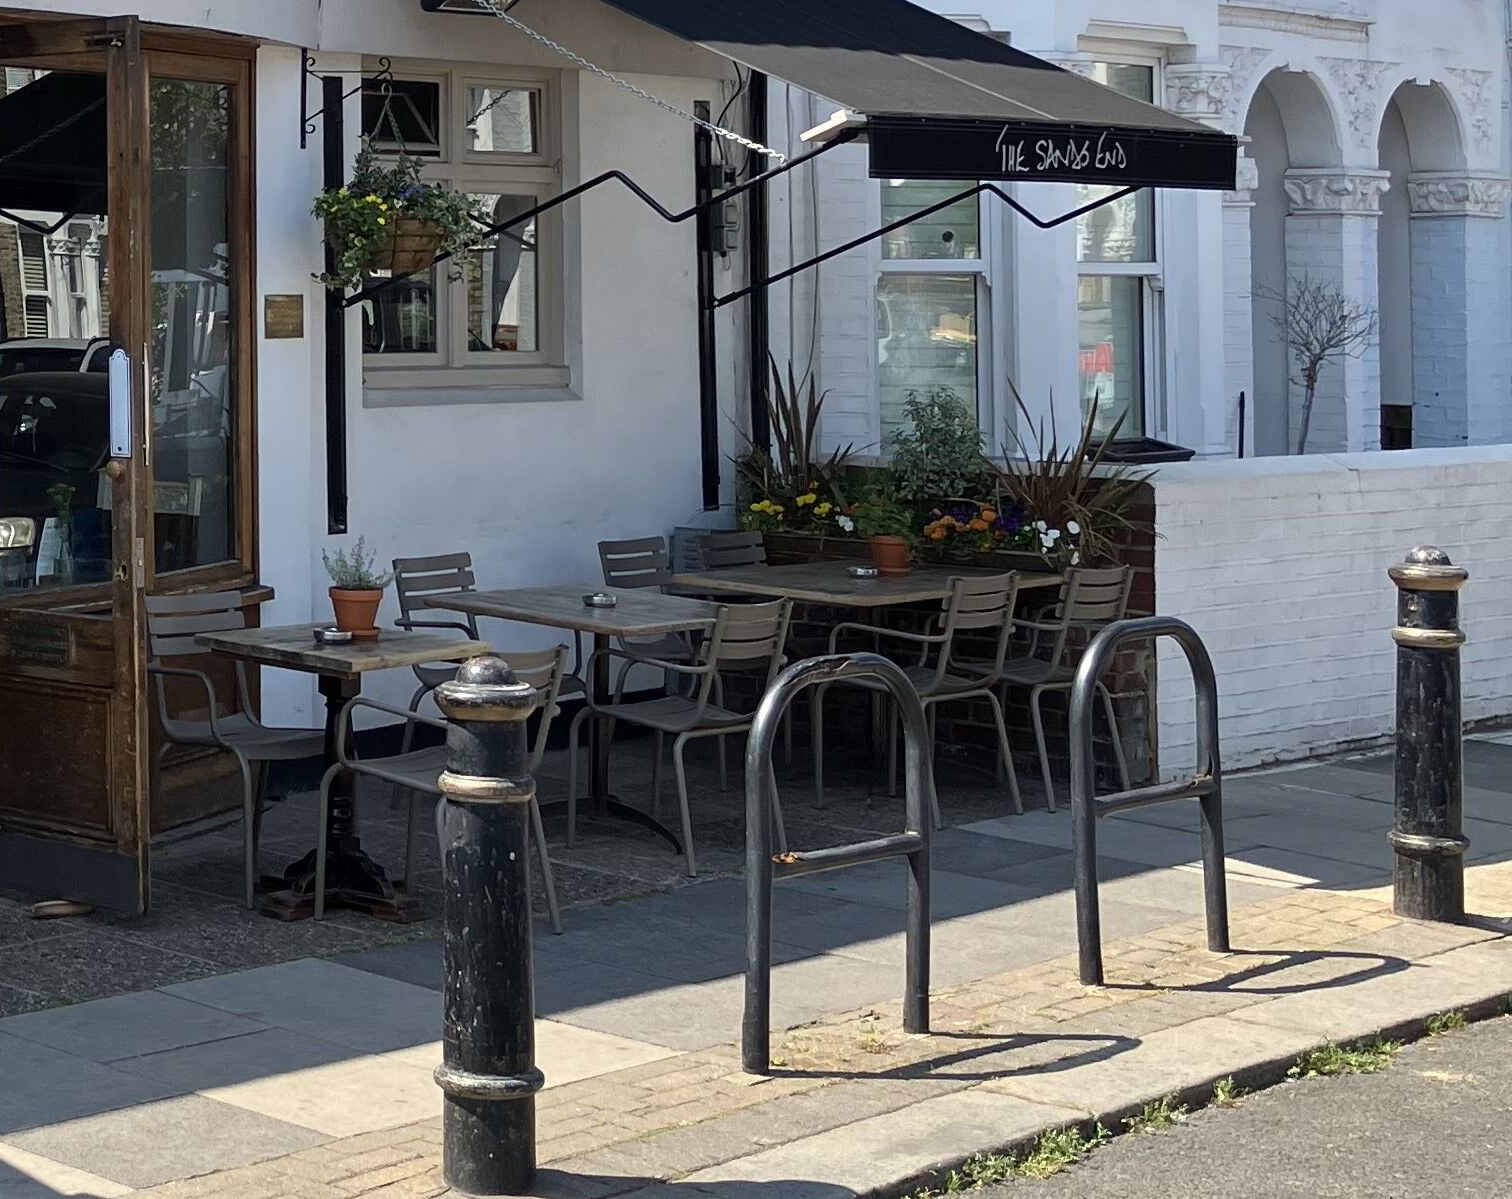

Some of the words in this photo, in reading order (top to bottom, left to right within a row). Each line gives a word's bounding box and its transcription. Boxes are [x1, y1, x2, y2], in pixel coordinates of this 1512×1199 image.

[996, 123, 1030, 173] THE
[1036, 138, 1090, 171] SANDS
[1095, 130, 1127, 170] END
